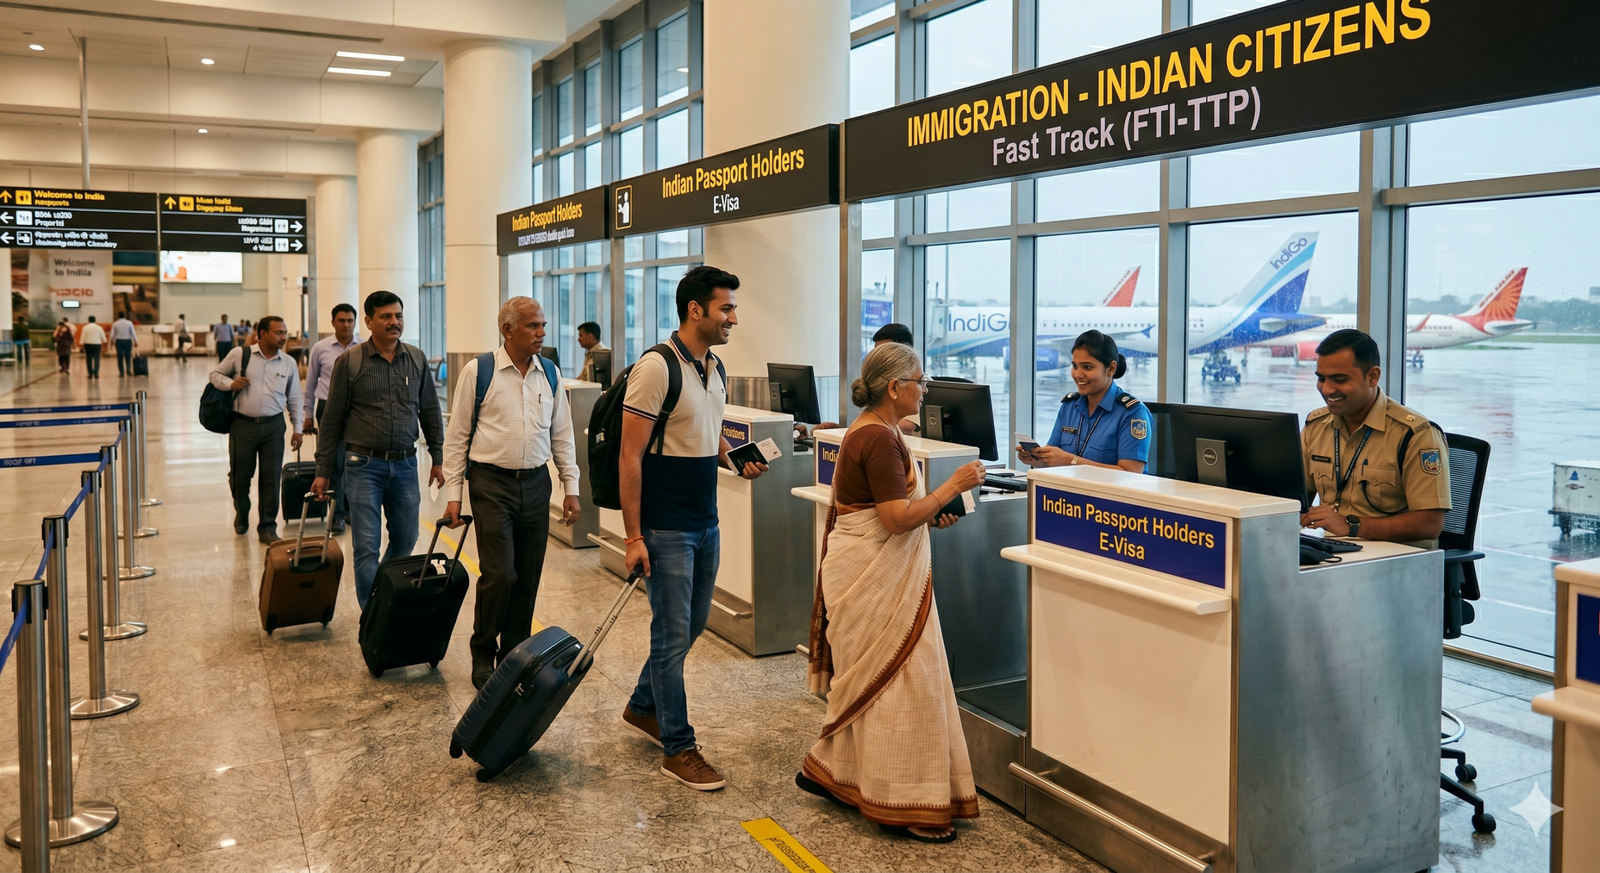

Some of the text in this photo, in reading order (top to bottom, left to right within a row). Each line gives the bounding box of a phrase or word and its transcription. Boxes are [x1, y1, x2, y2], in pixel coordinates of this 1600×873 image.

[907, 0, 1431, 147] IMMIGRATION - INDIAN CITIZENS
[993, 86, 1261, 166] Fast Track (FTI-TTP)
[662, 147, 805, 199] Indian Passport Holders
[34, 190, 73, 200] Welcome
[74, 192, 83, 200] to
[713, 193, 740, 214] E-Visa
[512, 201, 583, 232] Indian Passport Holders
[54, 258, 95, 267] Welcome
[1270, 237, 1308, 270] IndiGo
[55, 268, 64, 276] to
[948, 313, 1010, 332] IndiG
[1043, 494, 1215, 549] Indian Passport Holders
[1099, 531, 1145, 560] E-Visa
